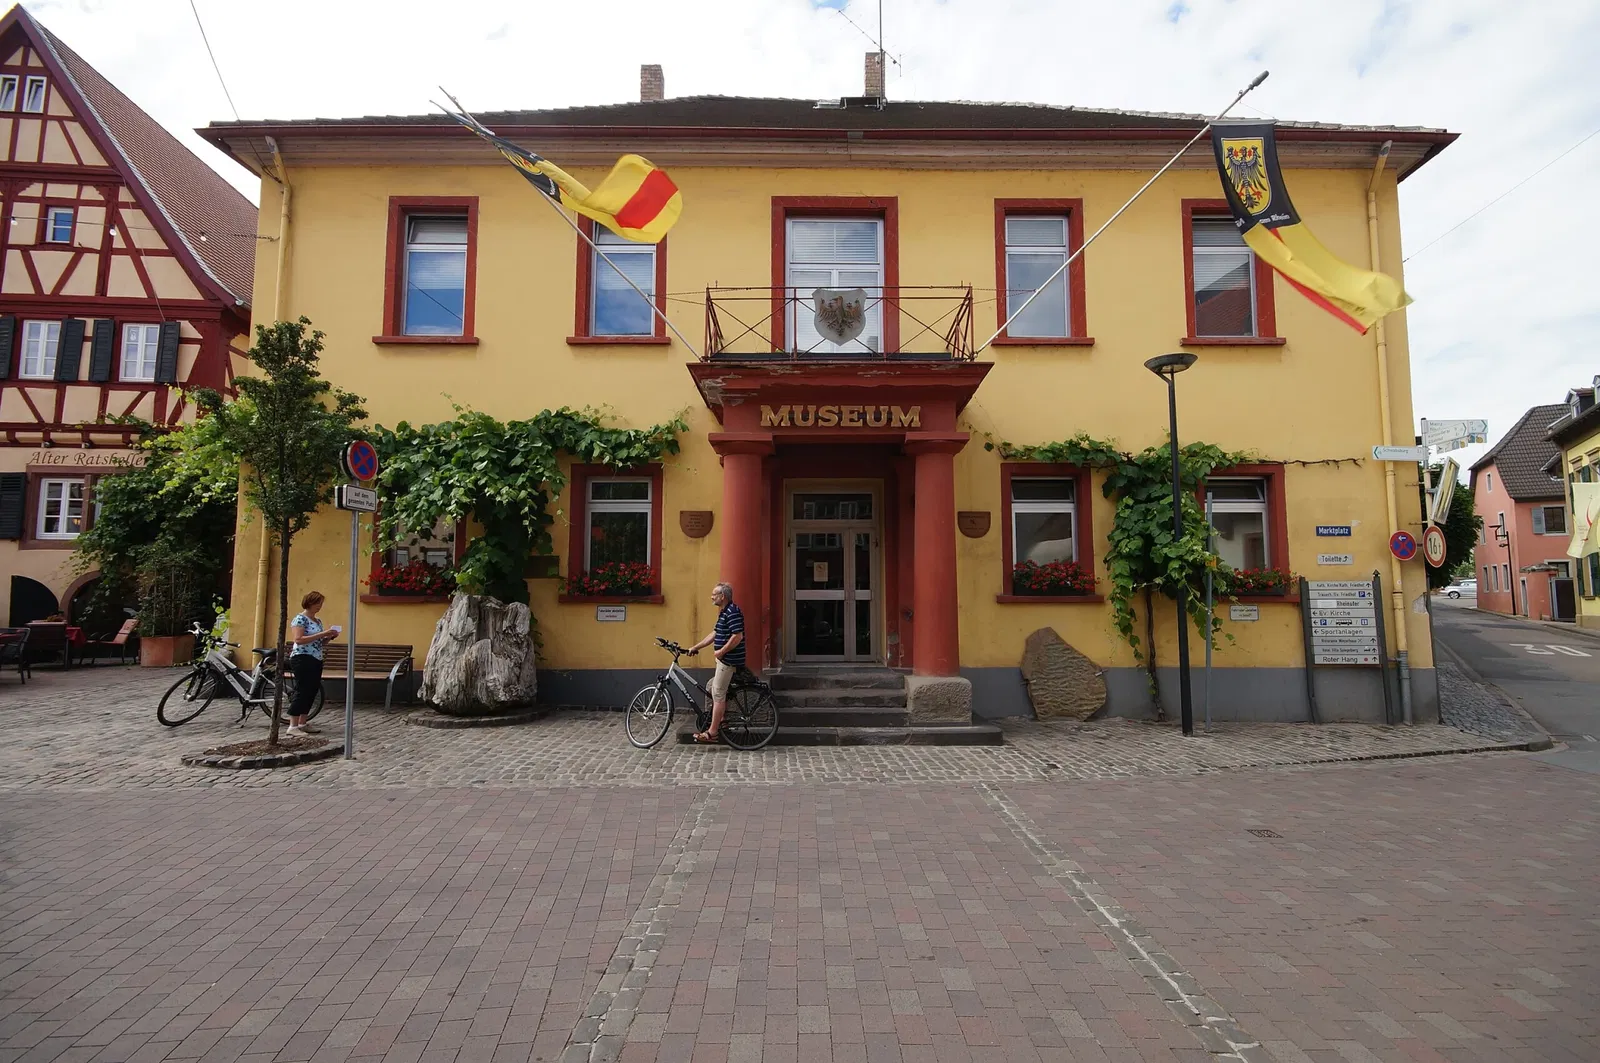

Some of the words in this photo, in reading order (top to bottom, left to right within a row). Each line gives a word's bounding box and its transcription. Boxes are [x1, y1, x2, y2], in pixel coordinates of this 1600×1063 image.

[760, 405, 921, 427] MUSEUM
[27, 451, 69, 465] Alter
[1318, 527, 1349, 536] Marktplatz
[1428, 537, 1438, 555] 16
[1321, 555, 1342, 563] Toilette
[1509, 643, 1593, 657] 30
